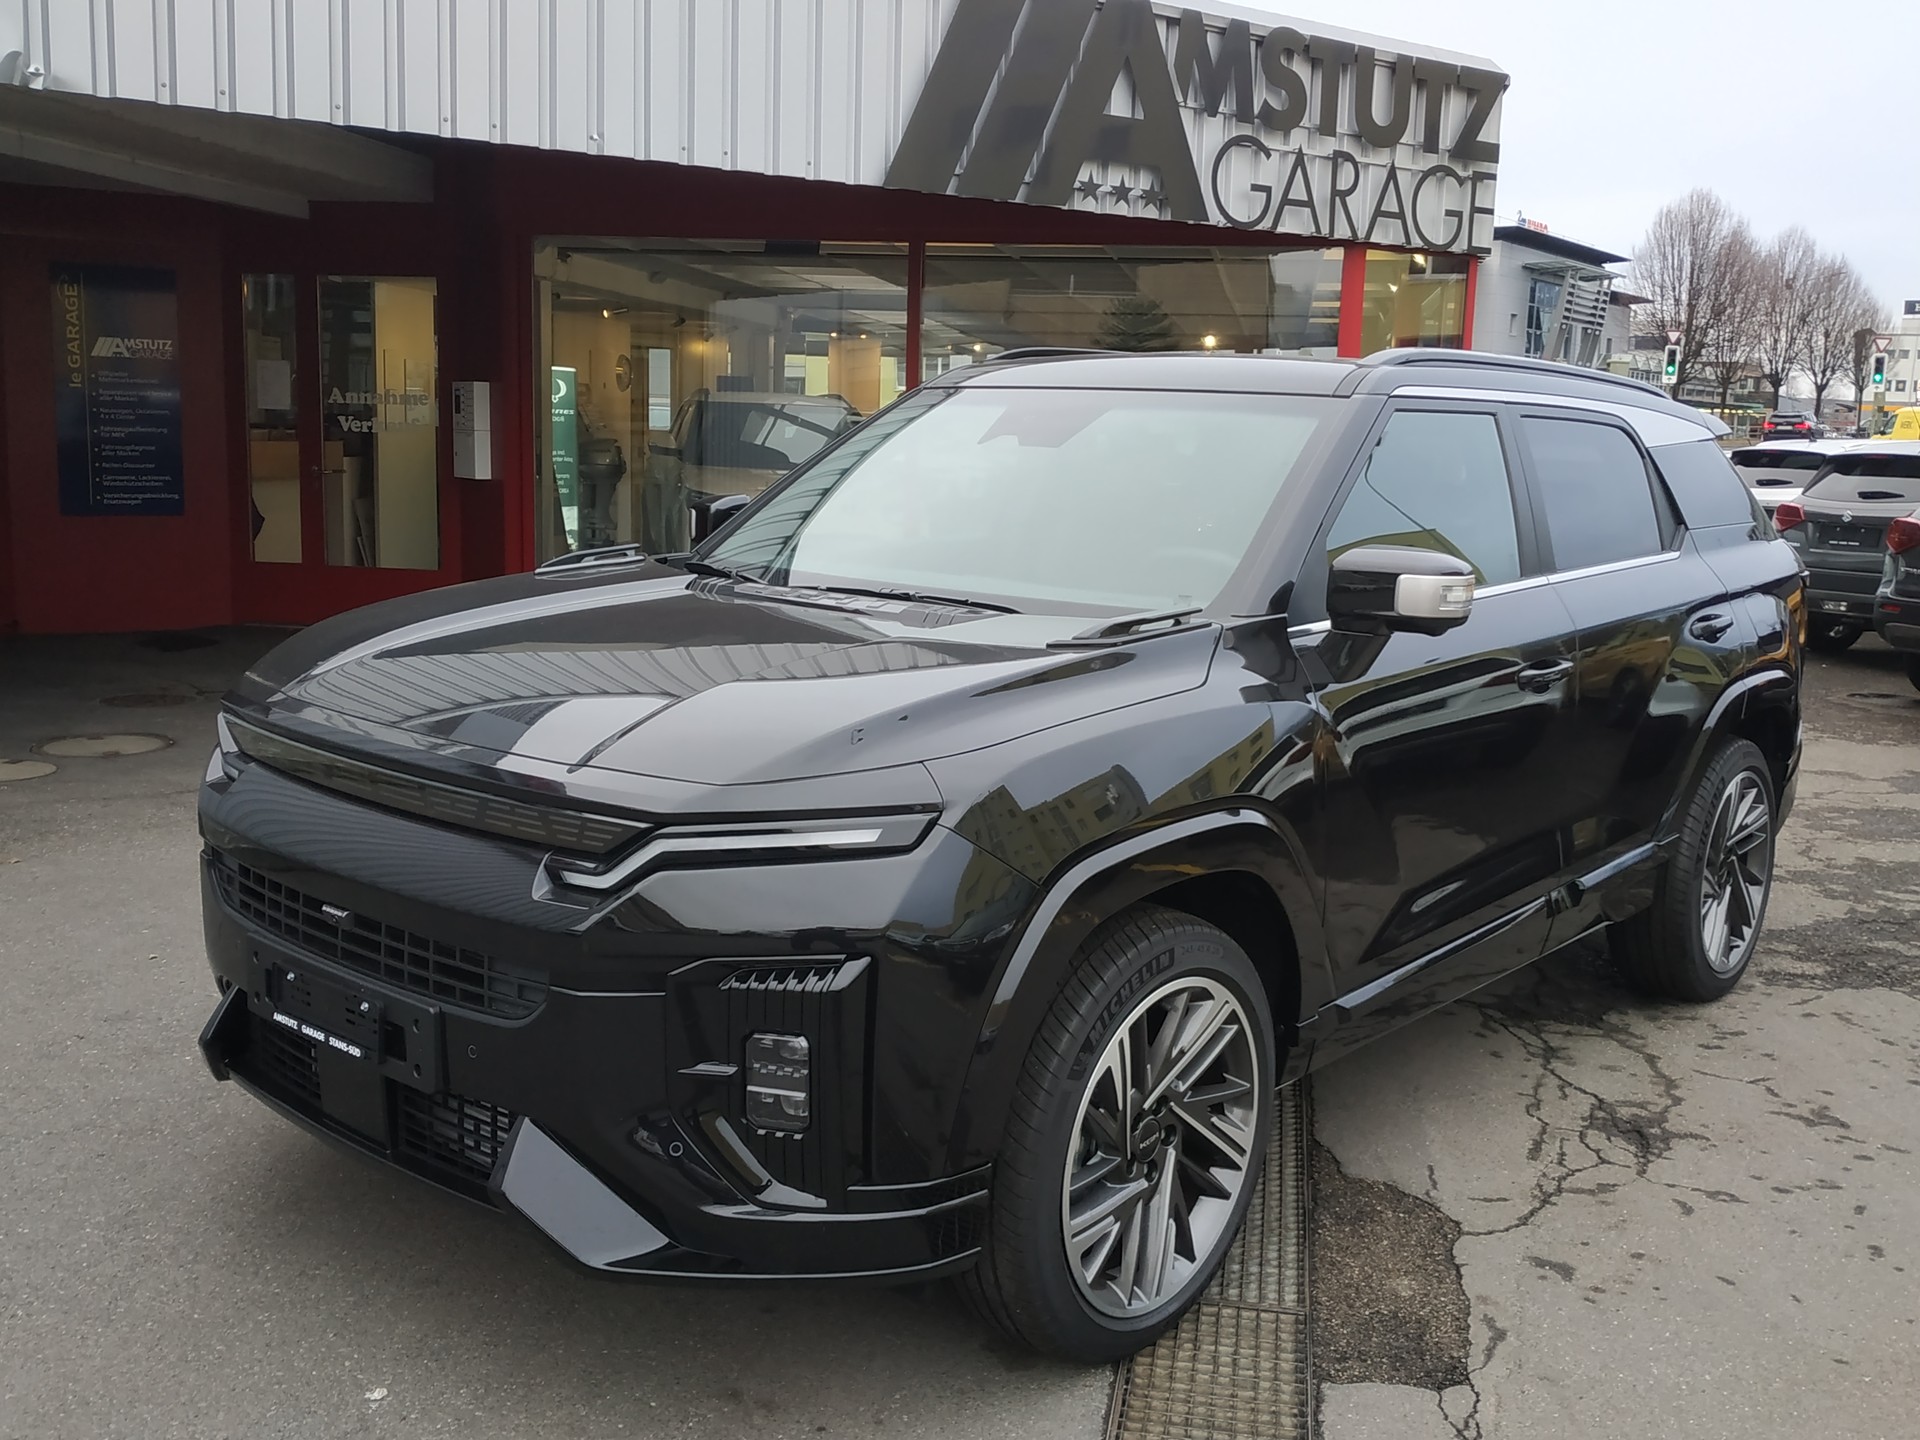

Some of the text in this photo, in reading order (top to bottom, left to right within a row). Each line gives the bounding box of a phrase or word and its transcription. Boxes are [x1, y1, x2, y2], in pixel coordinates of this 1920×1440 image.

[1016, 0, 1508, 222] AMSTUTZ
[1211, 134, 1497, 255] GARAGE
[64, 283, 82, 388] le GARAGE
[107, 337, 173, 357] AMSTUTZ
[128, 348, 173, 360] GARAGE
[327, 386, 429, 406] Annahme
[272, 1011, 362, 1058] AMSTUTZ GARAGE STANS-SÜD
[1088, 950, 1170, 1047] MICHELIN
